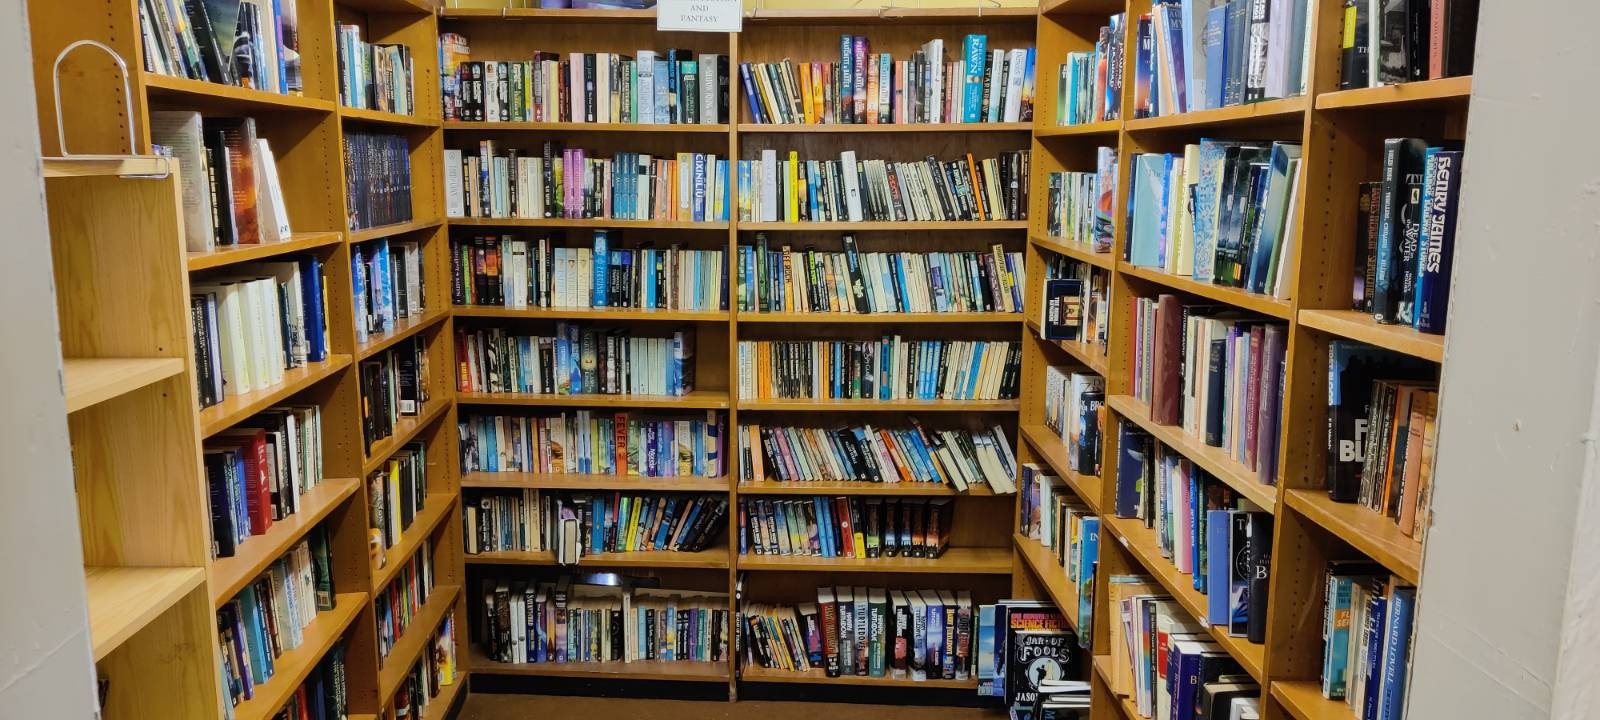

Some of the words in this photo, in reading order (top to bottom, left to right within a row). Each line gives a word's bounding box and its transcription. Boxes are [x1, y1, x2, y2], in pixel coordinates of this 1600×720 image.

[970, 38, 980, 74] RAWN
[695, 154, 704, 180] CIXIN
[1433, 156, 1451, 212] HENRY
[695, 182, 703, 198] LIU
[1403, 228, 1414, 262] WATER
[1411, 222, 1420, 252] DEAD
[1426, 214, 1445, 274] JAMES
[616, 415, 626, 448] FEVER
[839, 605, 847, 639] TURTLEDOVE
[857, 607, 866, 649] TURTLEDOVE
[870, 607, 878, 641] TURTLEDOVE
[1011, 619, 1043, 629] SCIENCE
[1390, 597, 1402, 646] BERNARD
[1021, 646, 1070, 663] FOOLS
[1026, 637, 1044, 645] JAR
[1386, 646, 1399, 684] LOVELL
